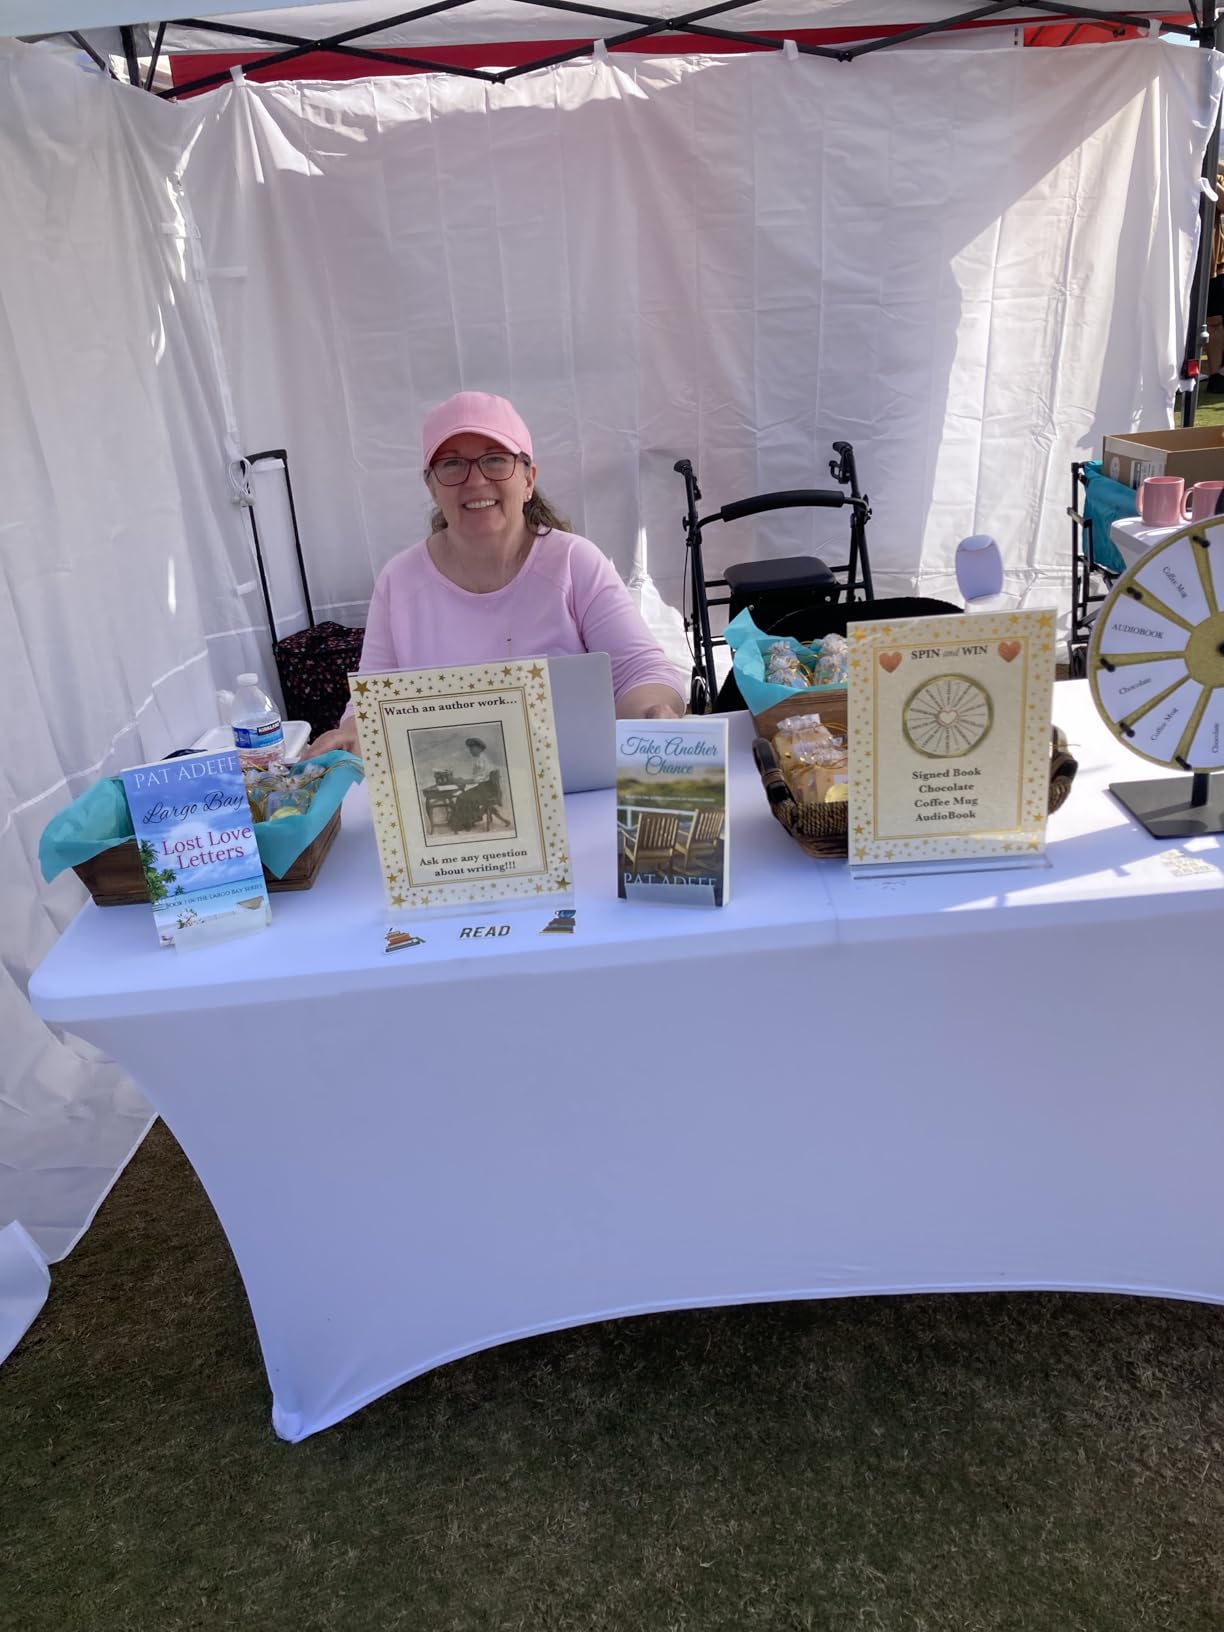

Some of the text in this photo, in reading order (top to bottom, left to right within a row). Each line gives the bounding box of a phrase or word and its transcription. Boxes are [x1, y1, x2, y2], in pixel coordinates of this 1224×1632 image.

[1112, 624, 1164, 639] AUDIOBOOK
[911, 645, 988, 659] SPIN and WIN
[1119, 678, 1151, 694] Chocolate
[384, 705, 419, 716] Watch
[439, 701, 475, 711] author
[478, 697, 517, 707] work...
[620, 736, 719, 756] Take Another
[134, 756, 237, 789] PAT ADEFF
[645, 755, 694, 776] Chance
[912, 767, 982, 781] Signed Book
[918, 783, 975, 793] Chocolate
[143, 791, 244, 824] Largo Bay
[914, 796, 979, 807] Coffee Mug
[915, 810, 976, 821] AudioBook
[162, 827, 252, 856] Lost Love
[177, 846, 245, 870] Letters
[420, 857, 439, 866] Ask
[461, 855, 480, 863] any
[482, 849, 528, 862] question
[434, 861, 516, 877] about writing!!!
[460, 925, 511, 938] READ
